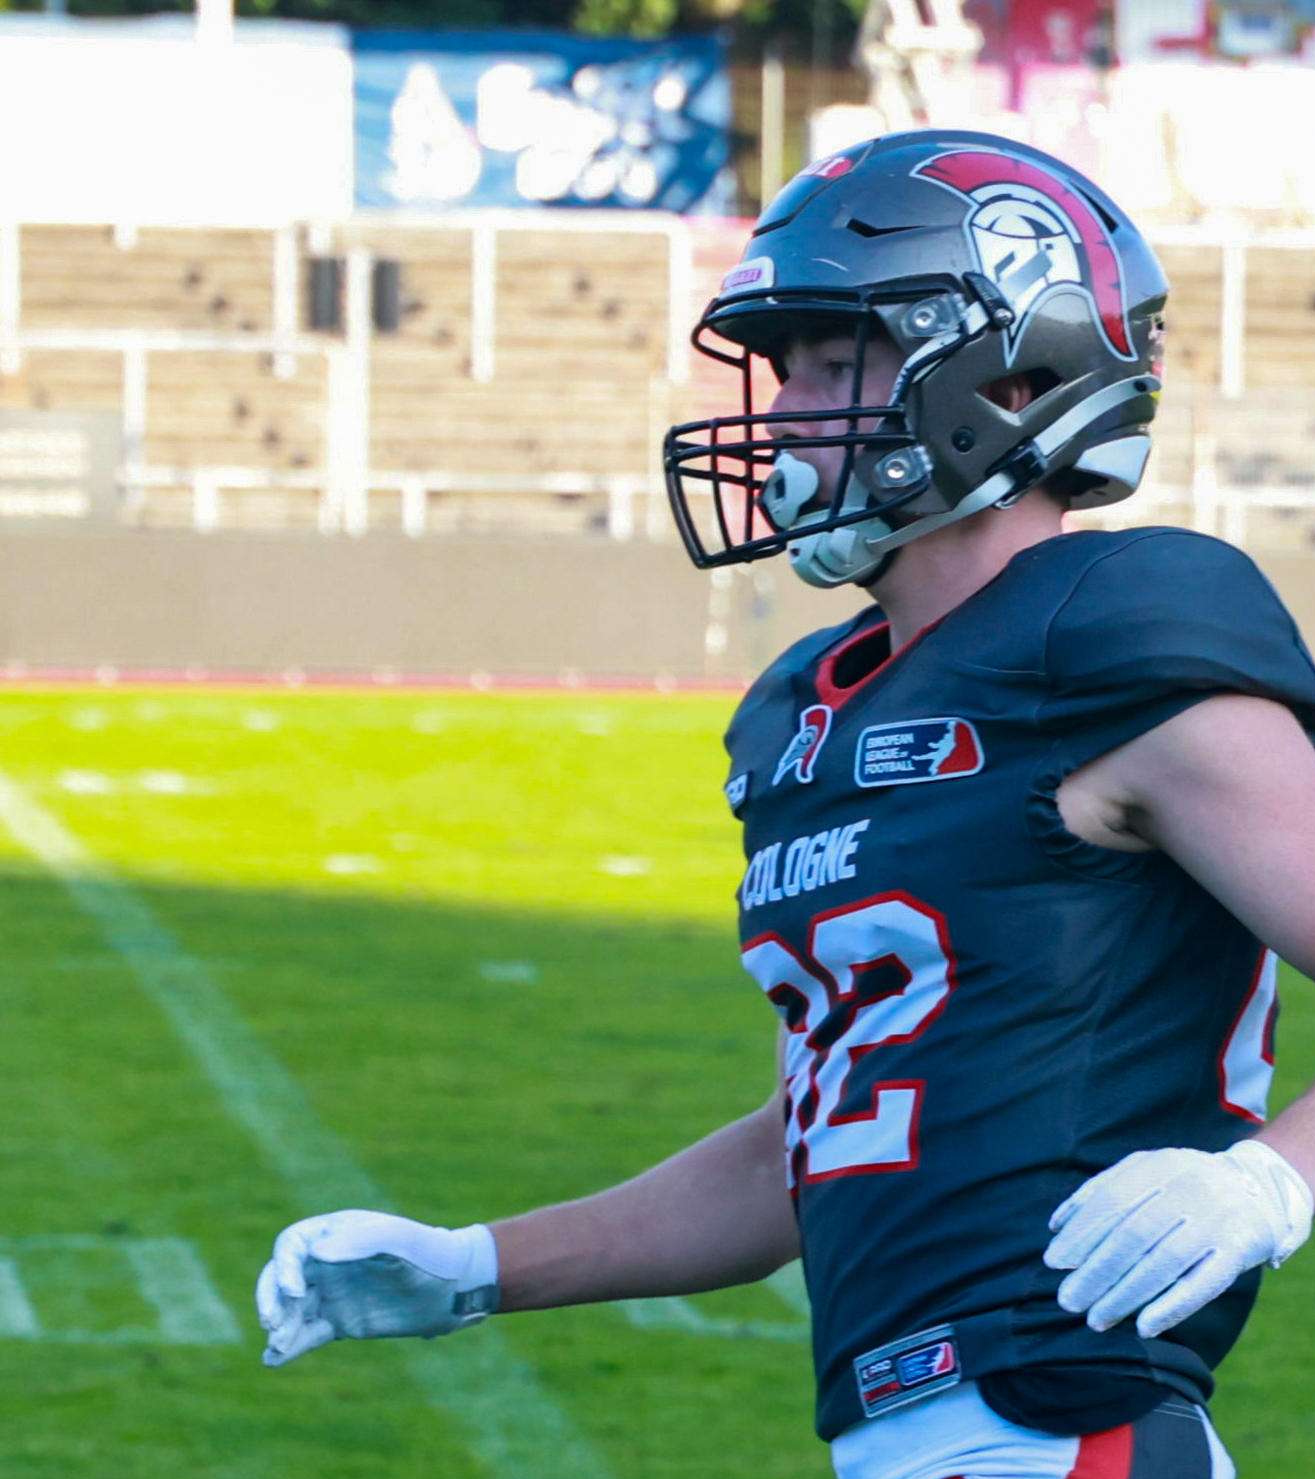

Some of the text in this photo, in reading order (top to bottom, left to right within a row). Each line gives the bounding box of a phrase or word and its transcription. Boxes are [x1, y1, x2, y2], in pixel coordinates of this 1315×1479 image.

[865, 732, 915, 749] EUROPEAN
[865, 747, 901, 762] LEAGUE
[864, 759, 917, 775] FOOTBALL
